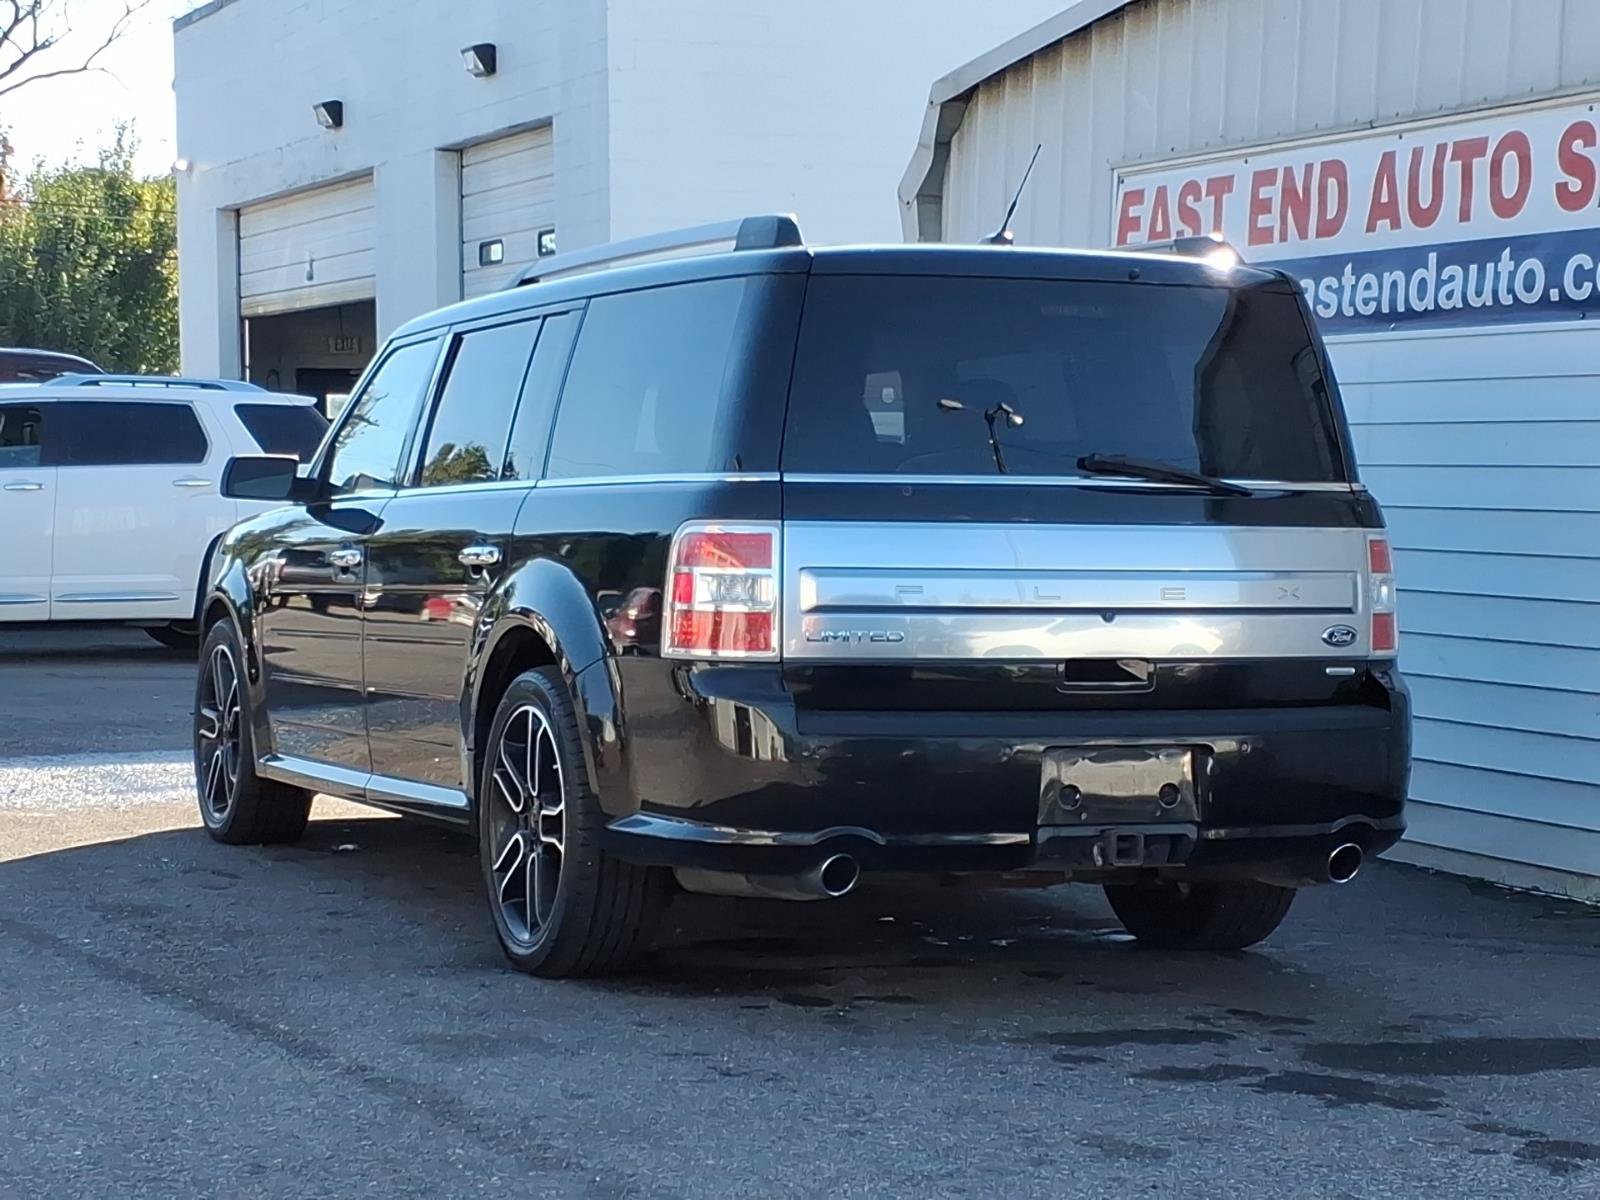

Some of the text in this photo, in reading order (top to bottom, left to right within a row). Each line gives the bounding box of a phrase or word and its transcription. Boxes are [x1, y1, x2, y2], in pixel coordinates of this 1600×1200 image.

[1116, 120, 1600, 246] EAST END AUTO S
[1299, 246, 1600, 319] astendauto.c
[805, 630, 905, 642] LIMITED
